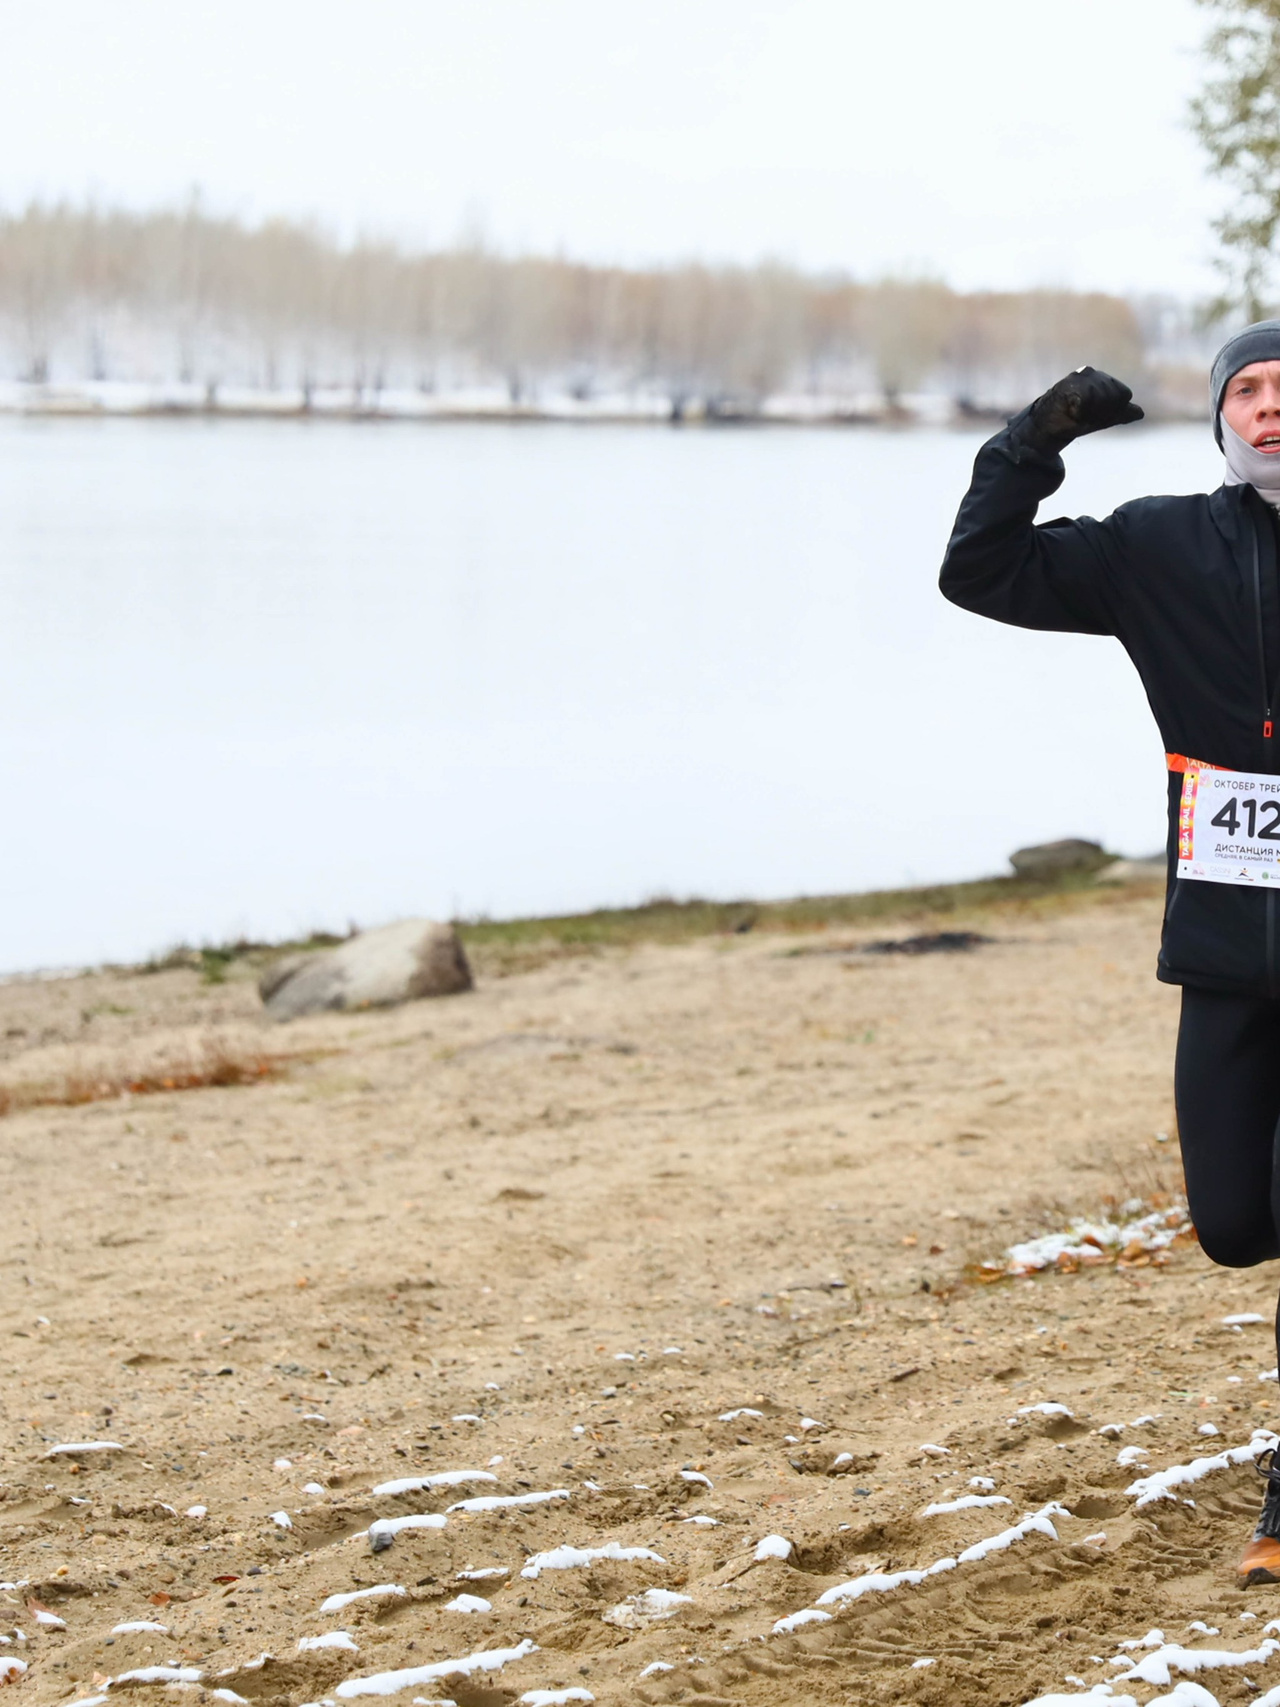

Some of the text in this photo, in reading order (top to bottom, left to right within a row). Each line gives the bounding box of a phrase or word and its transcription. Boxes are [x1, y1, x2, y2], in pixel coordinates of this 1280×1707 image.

[1214, 779, 1256, 791] ОКТОБЕР
[1182, 778, 1194, 857] TAIGA TRAIL SERIES
[1215, 843, 1273, 856] ДИСТАНЦИЯ
